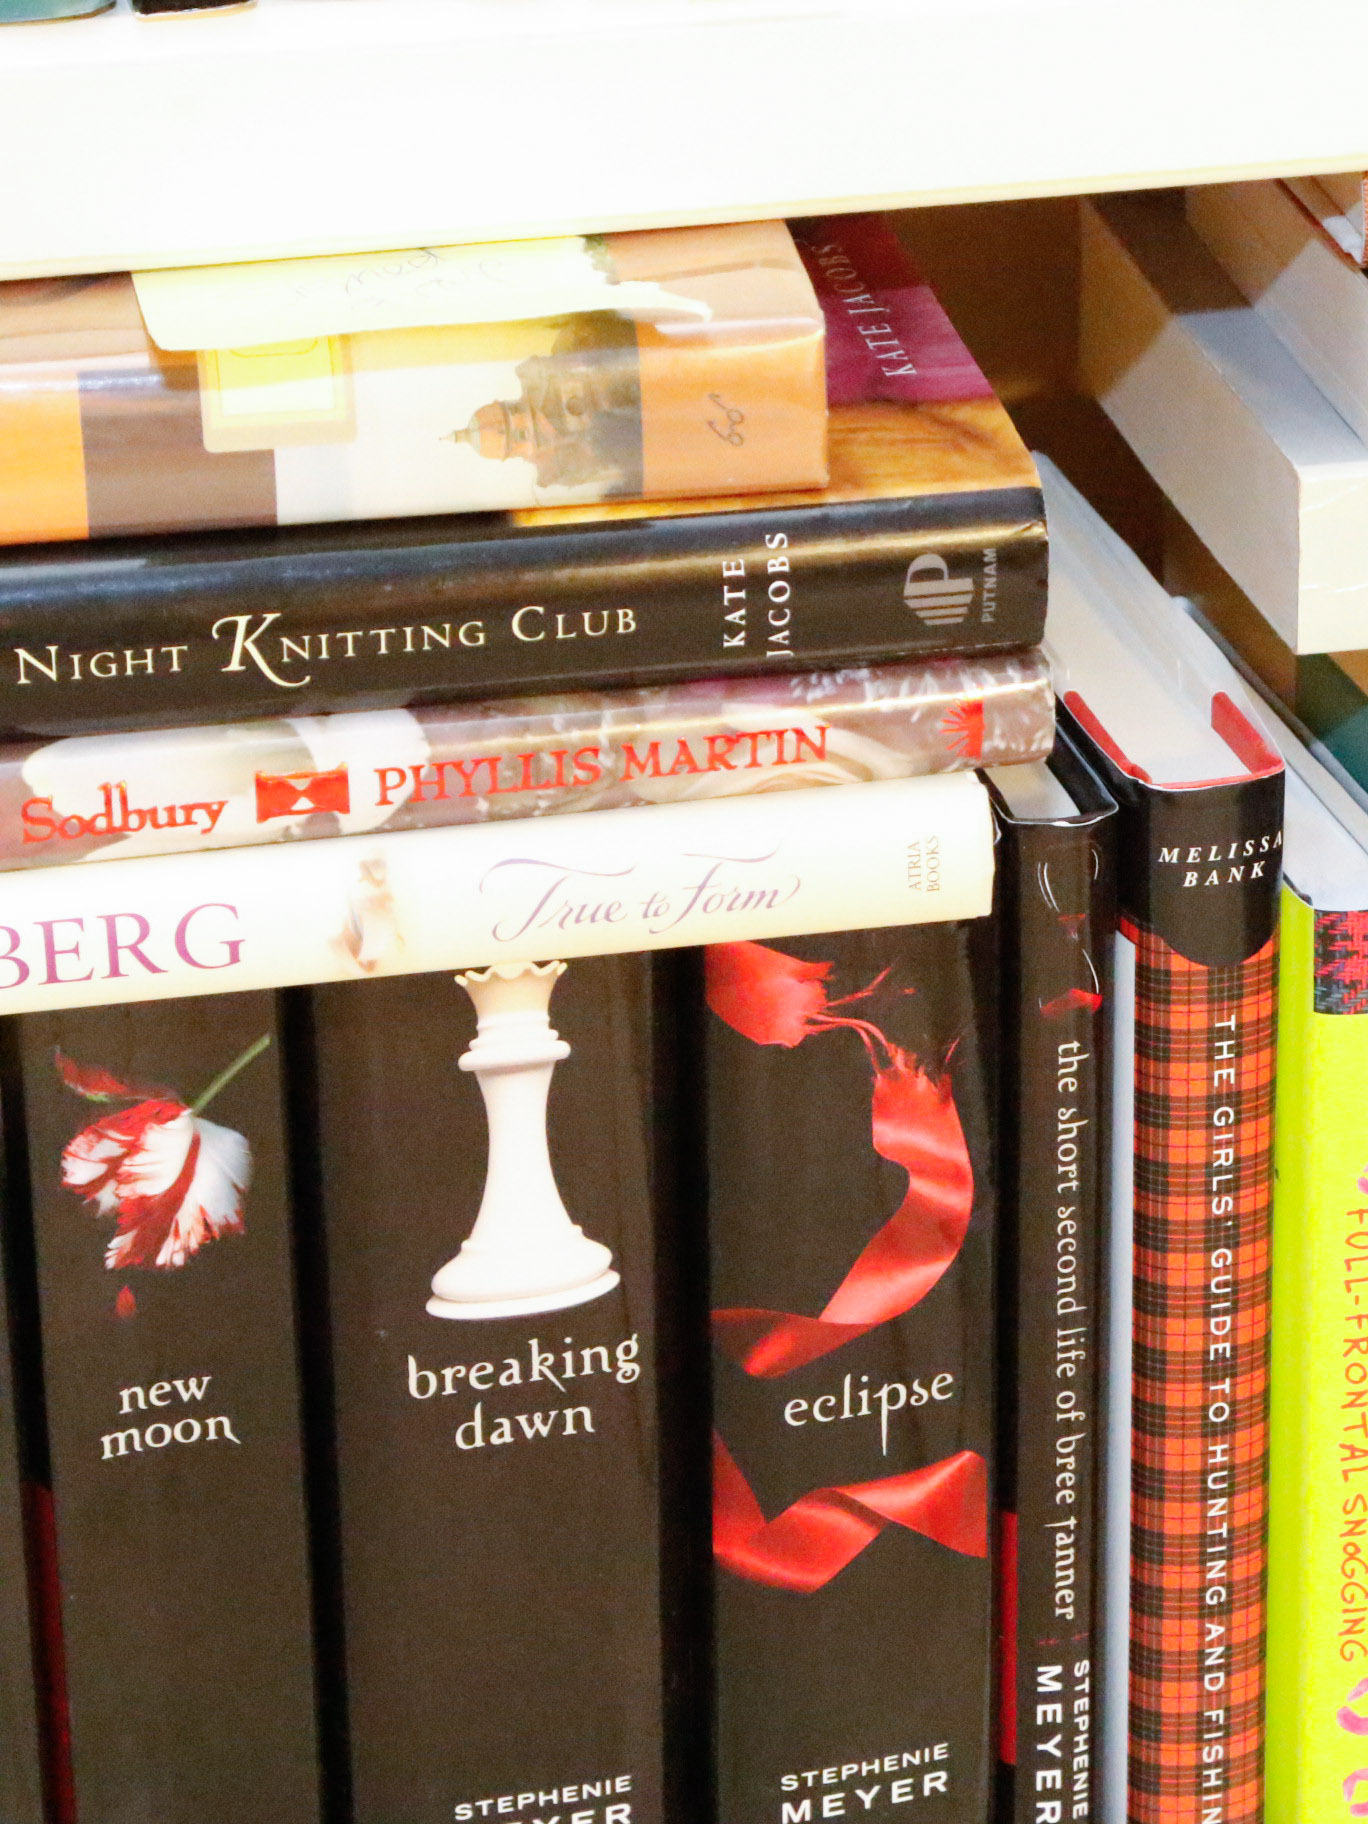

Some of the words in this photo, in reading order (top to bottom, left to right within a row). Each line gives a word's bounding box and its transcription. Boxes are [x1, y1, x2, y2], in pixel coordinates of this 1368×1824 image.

[811, 243, 891, 316] JACOBS
[857, 323, 917, 377] KATE
[722, 558, 746, 648] KATE
[765, 532, 794, 657] JACOBS
[981, 547, 997, 623] PUTNAM
[15, 644, 188, 685] NIGHT
[511, 605, 637, 642] CLUB
[20, 780, 229, 845] Sodbury
[374, 746, 601, 807] PHYLLIS
[619, 722, 832, 783] MARTIN
[908, 840, 921, 891] ATRIA
[926, 834, 941, 893] BOOKS
[1158, 831, 1283, 863] MELISSA
[1183, 860, 1266, 888] BANK
[478, 857, 636, 943] True
[640, 891, 670, 920] to
[649, 840, 801, 935] Form
[1057, 1040, 1090, 1093] the
[1214, 1015, 1236, 1087] THE
[1057, 1104, 1087, 1193] short
[1212, 1106, 1235, 1228] GIRLS'
[1056, 1205, 1088, 1316] second
[1210, 1248, 1234, 1361] GUIDE
[407, 1333, 641, 1400] breaking
[1056, 1325, 1086, 1379] life
[118, 1374, 212, 1414] new
[454, 1402, 595, 1450] dawn
[783, 1371, 955, 1456] eclipse
[1055, 1390, 1085, 1424] of
[1207, 1378, 1231, 1423] TO
[99, 1415, 241, 1461] moon
[1055, 1433, 1085, 1506] bree
[1204, 1445, 1231, 1606] HUNTING
[1045, 1514, 1076, 1621] tanner
[1203, 1623, 1227, 1692] AND
[780, 1742, 949, 1791] STEPHENIE
[1036, 1665, 1063, 1824] MEYER
[1073, 1659, 1090, 1819] STEPHENIE
[454, 1775, 632, 1821] STEPHENIE
[780, 1771, 948, 1824] MEYER
